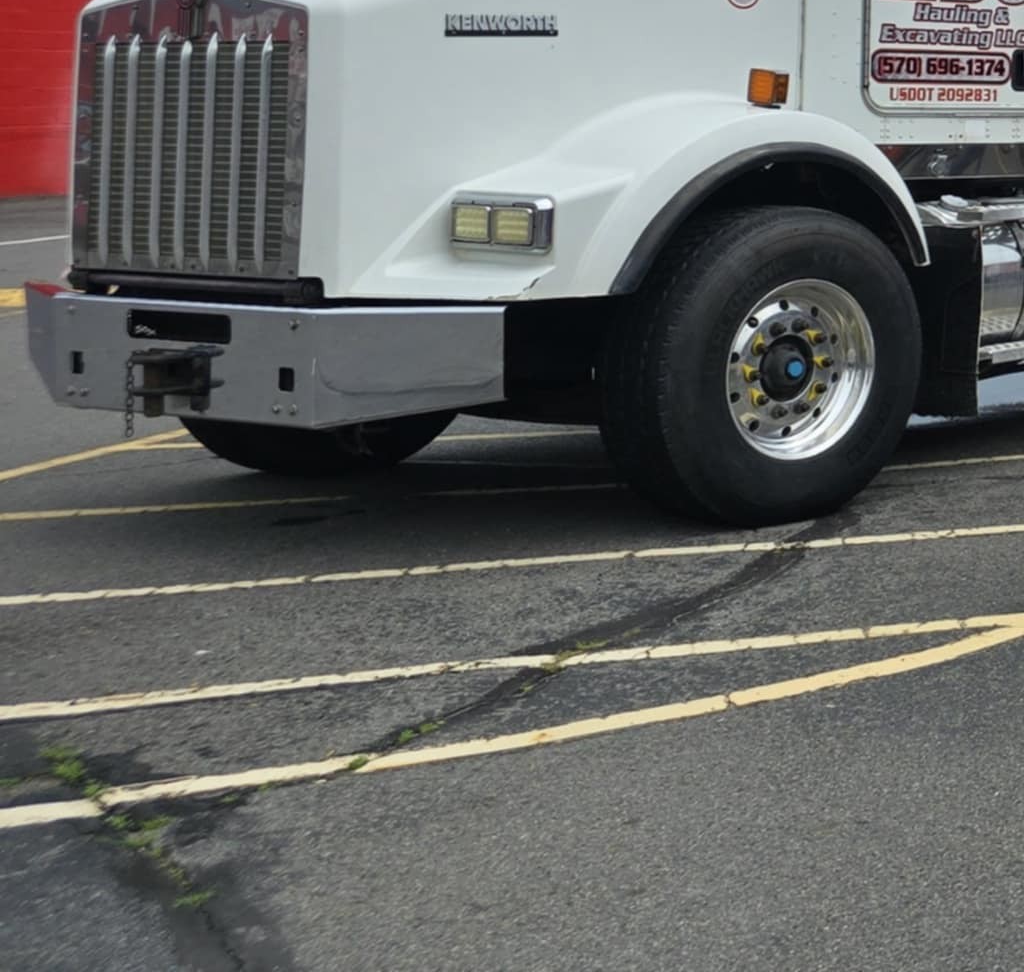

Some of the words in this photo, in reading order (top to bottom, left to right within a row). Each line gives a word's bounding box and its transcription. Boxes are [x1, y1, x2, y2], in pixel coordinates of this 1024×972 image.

[444, 13, 558, 37] KENWORTH
[913, 2, 993, 29] Hauling
[994, 6, 1011, 26] &
[879, 23, 993, 50] Excavating
[877, 56, 922, 77] (570)
[925, 57, 1006, 77] 696-1374
[889, 87, 934, 102] USDOT
[937, 88, 998, 103] 2092831
